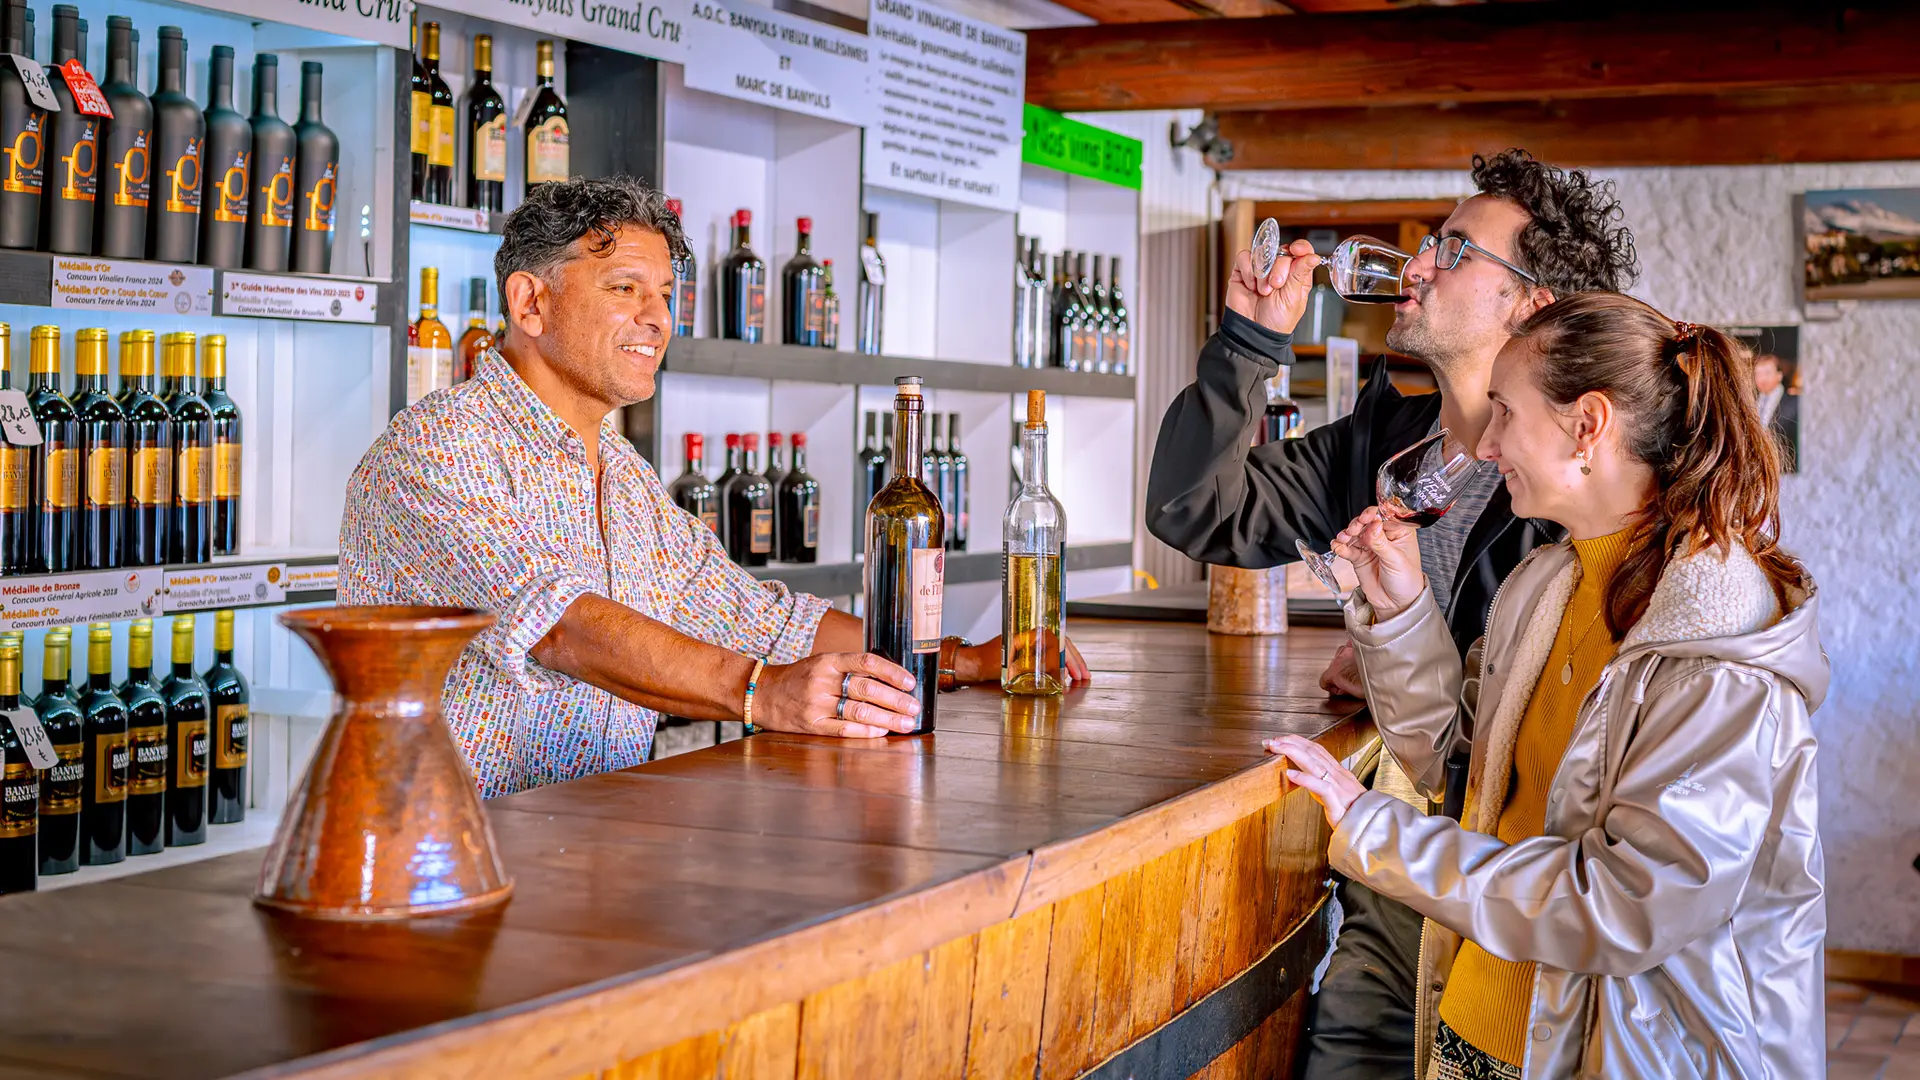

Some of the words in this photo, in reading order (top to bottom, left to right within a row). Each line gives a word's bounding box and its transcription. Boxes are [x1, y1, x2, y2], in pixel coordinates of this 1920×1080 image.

[647, 6, 682, 42] Cru
[729, 12, 777, 39] BANYULS
[780, 25, 810, 46] VIEUX
[965, 24, 977, 42] DE
[779, 55, 792, 70] ET
[736, 74, 767, 95] MARC
[770, 81, 783, 100] DE
[787, 86, 831, 109] BANYULS
[1105, 139, 1133, 177] BIO
[59, 262, 92, 272] Médaille
[94, 263, 111, 273] d'Or
[66, 272, 97, 282] Concours
[126, 276, 146, 284] France
[57, 285, 91, 295] Médaille
[93, 287, 110, 296] d'Or
[117, 288, 136, 298] Coup
[149, 291, 168, 299] Cœur
[241, 283, 262, 292] Guide
[264, 284, 295, 294] Hachette
[296, 287, 308, 295] des
[309, 288, 322, 296] Vins
[65, 296, 96, 305] Concours
[98, 297, 115, 306] Terre
[116, 298, 124, 306] de
[126, 298, 139, 306] Vins
[140, 299, 156, 307] 2024
[238, 306, 265, 314] Concours
[267, 307, 292, 315] Mondial
[293, 308, 300, 316] de
[1, 404, 31, 423] 28,15
[170, 576, 201, 586] Médaille
[203, 575, 218, 584] d'Or
[239, 572, 253, 581] 2022
[2, 585, 41, 596] Médaille
[42, 584, 52, 592] de
[54, 582, 80, 591] Bronze
[170, 588, 201, 599] Médaille
[202, 587, 230, 597] d'Argent
[919, 585, 930, 595] de
[12, 596, 46, 605] Concours
[47, 591, 74, 602] Général
[75, 589, 102, 600] Agricole
[103, 588, 118, 597] 2018
[177, 599, 207, 609] Grenache
[217, 596, 237, 605] Monde
[237, 594, 251, 602] 2022
[2, 608, 39, 620] Médaille
[41, 607, 60, 617] d'Or
[12, 620, 45, 629] Concours
[46, 616, 75, 626] Mondial
[75, 615, 87, 623] des
[88, 611, 122, 621] Féminalise
[123, 609, 139, 617] 2022
[50, 774, 76, 782] GRAND
[5, 793, 31, 803] GRAND
